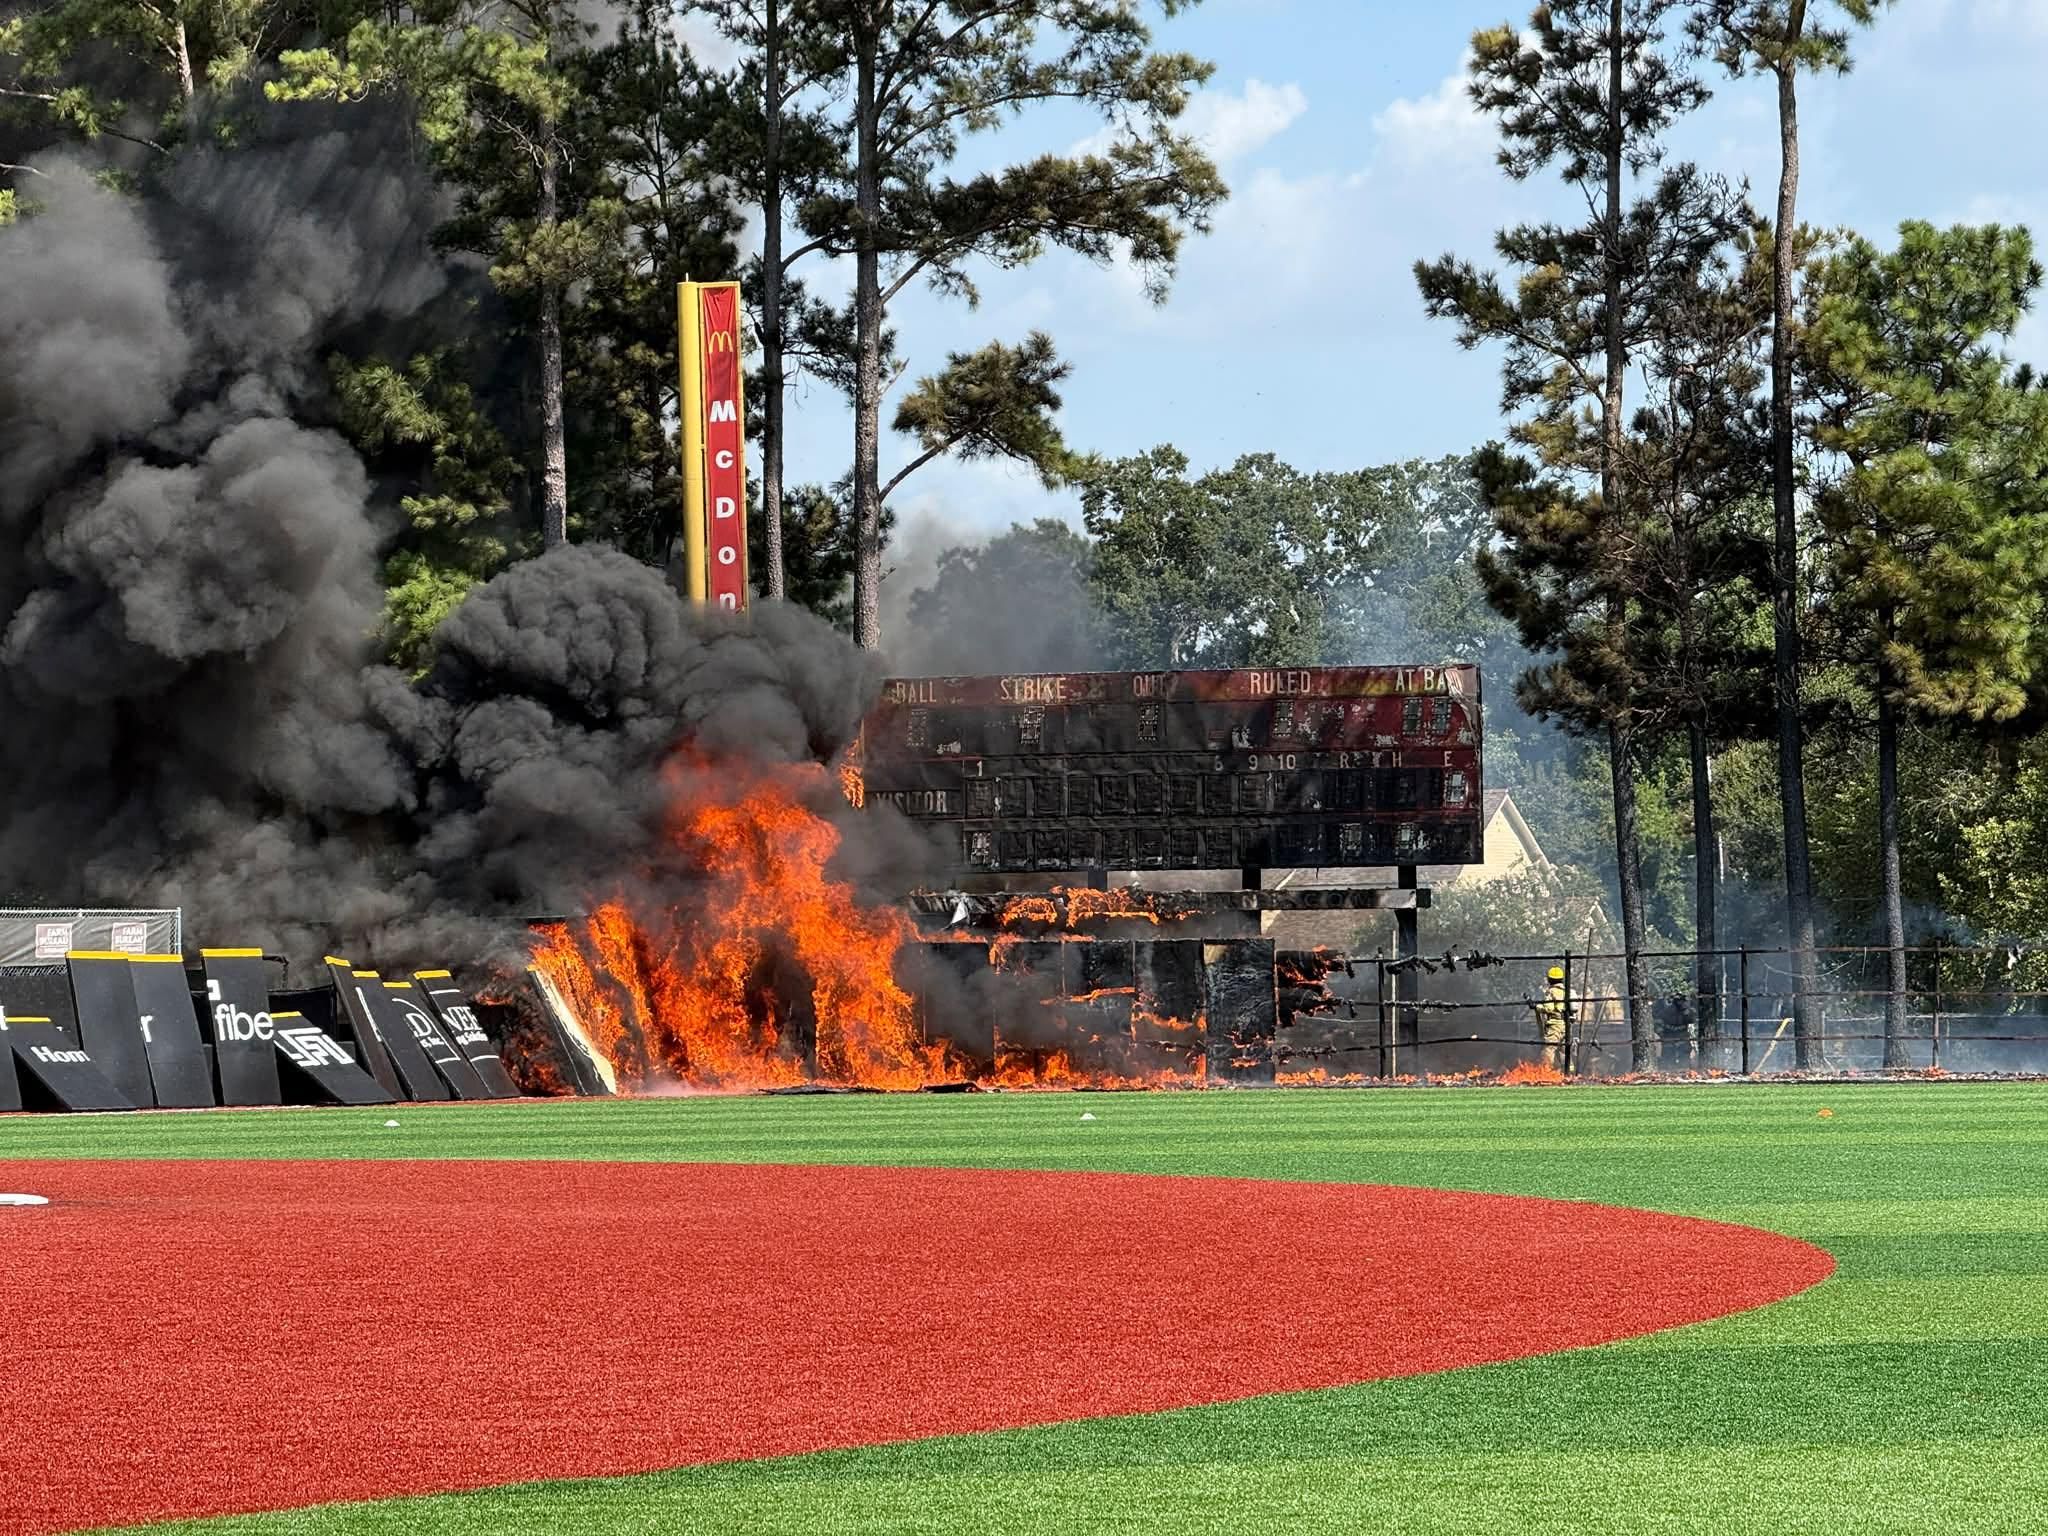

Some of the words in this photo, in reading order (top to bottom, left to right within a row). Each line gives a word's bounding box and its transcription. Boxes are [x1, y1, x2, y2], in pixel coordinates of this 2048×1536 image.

[1250, 671, 1311, 694] RULED
[1395, 669, 1415, 691] AT
[1424, 668, 1449, 691] BA
[896, 681, 936, 703] BALL
[1248, 754, 1258, 770] 9
[1277, 754, 1296, 770] 10
[1339, 752, 1350, 768] R
[1444, 751, 1453, 767] E
[215, 1003, 274, 1041] fibe
[30, 1046, 91, 1063] Hom
